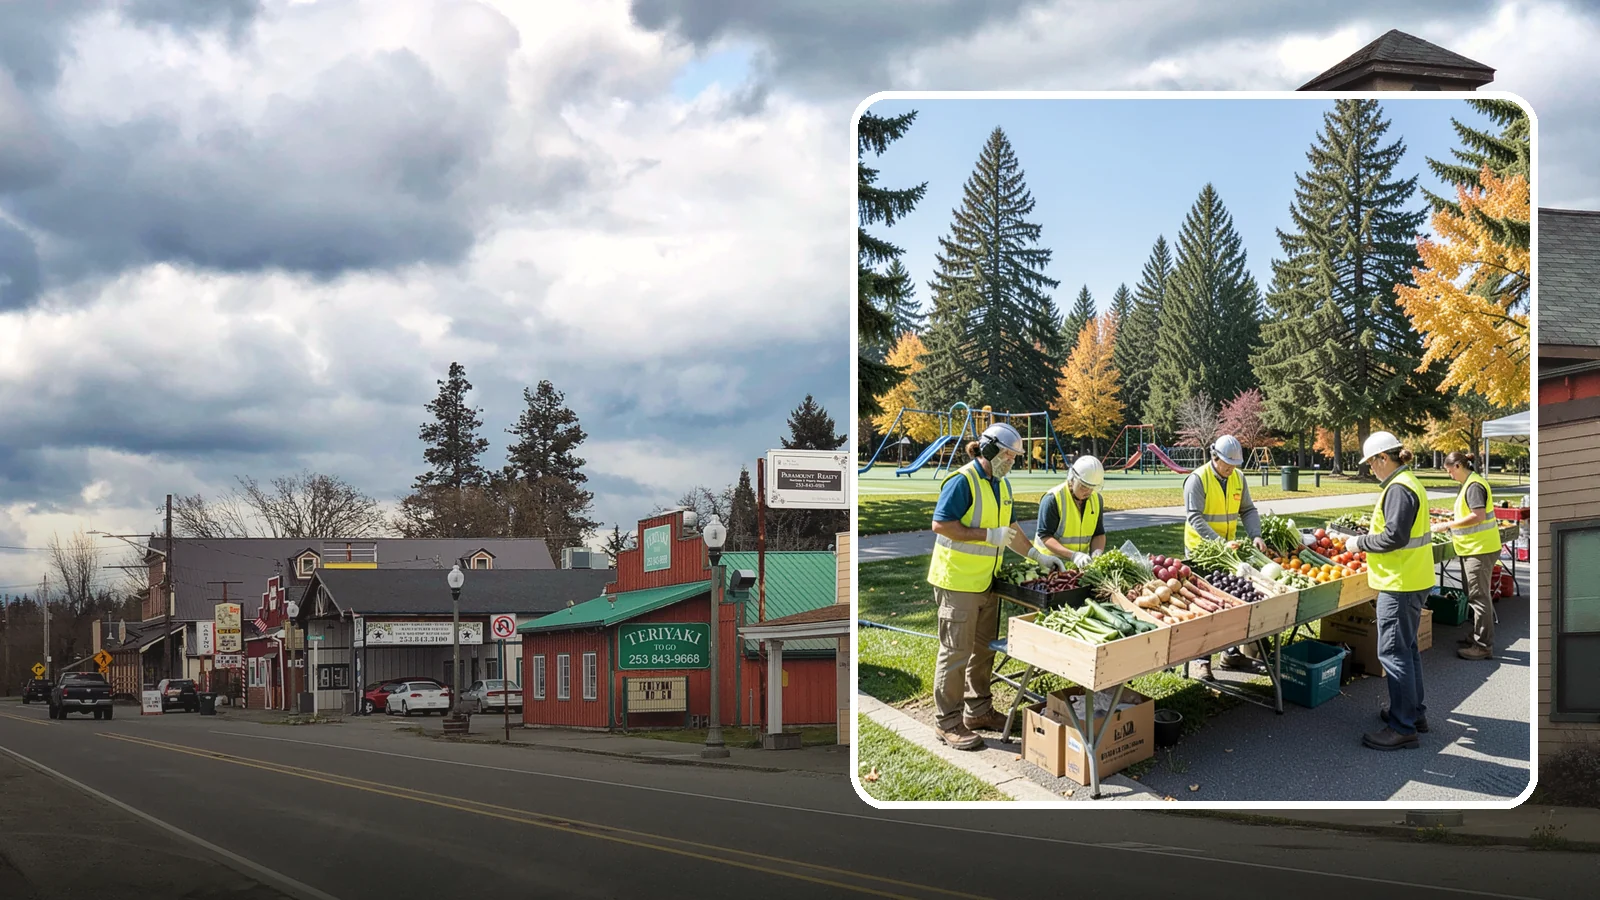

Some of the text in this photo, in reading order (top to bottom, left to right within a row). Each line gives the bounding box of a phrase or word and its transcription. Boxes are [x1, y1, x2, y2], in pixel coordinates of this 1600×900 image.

[625, 627, 702, 646] TERIYAKI
[629, 654, 700, 664] 253 843-9668
